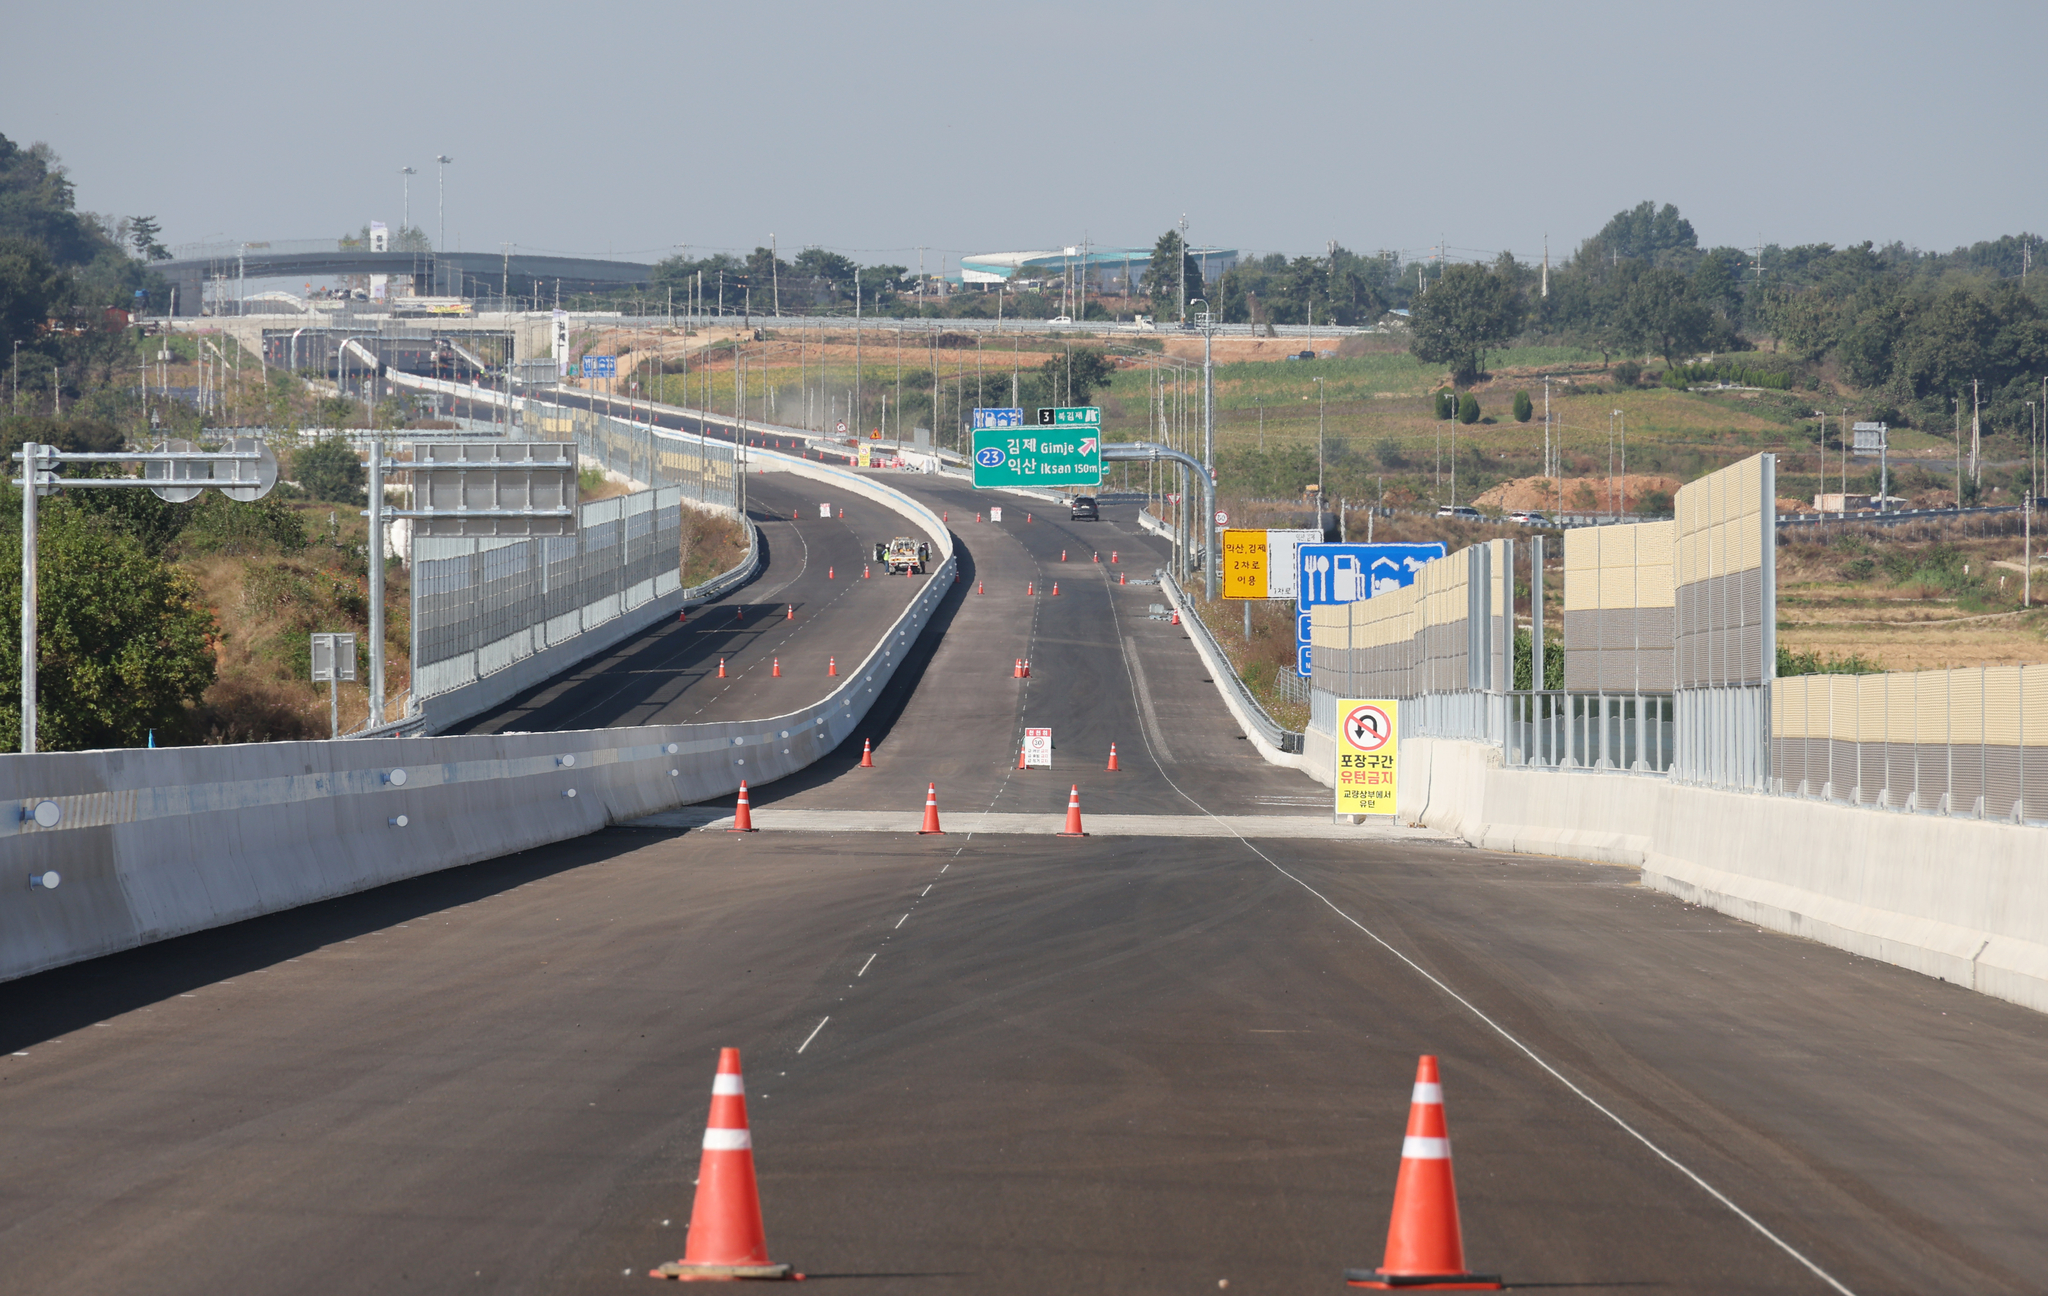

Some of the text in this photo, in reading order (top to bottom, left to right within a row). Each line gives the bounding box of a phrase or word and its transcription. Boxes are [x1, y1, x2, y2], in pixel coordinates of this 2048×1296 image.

[1043, 411, 1050, 422] 3
[1058, 411, 1083, 422] 북김제
[1007, 438, 1036, 455] 김제
[1040, 442, 1075, 456] Gimje
[982, 451, 999, 464] 23
[1008, 458, 1036, 475] 익산
[1040, 463, 1098, 474] Iksan 150m
[1237, 575, 1256, 586] 이용
[1341, 755, 1394, 768] 포장구간
[1341, 771, 1393, 784] 유턴금지
[1344, 790, 1391, 798] 교량상부에서
[1360, 800, 1375, 808] 유턴
